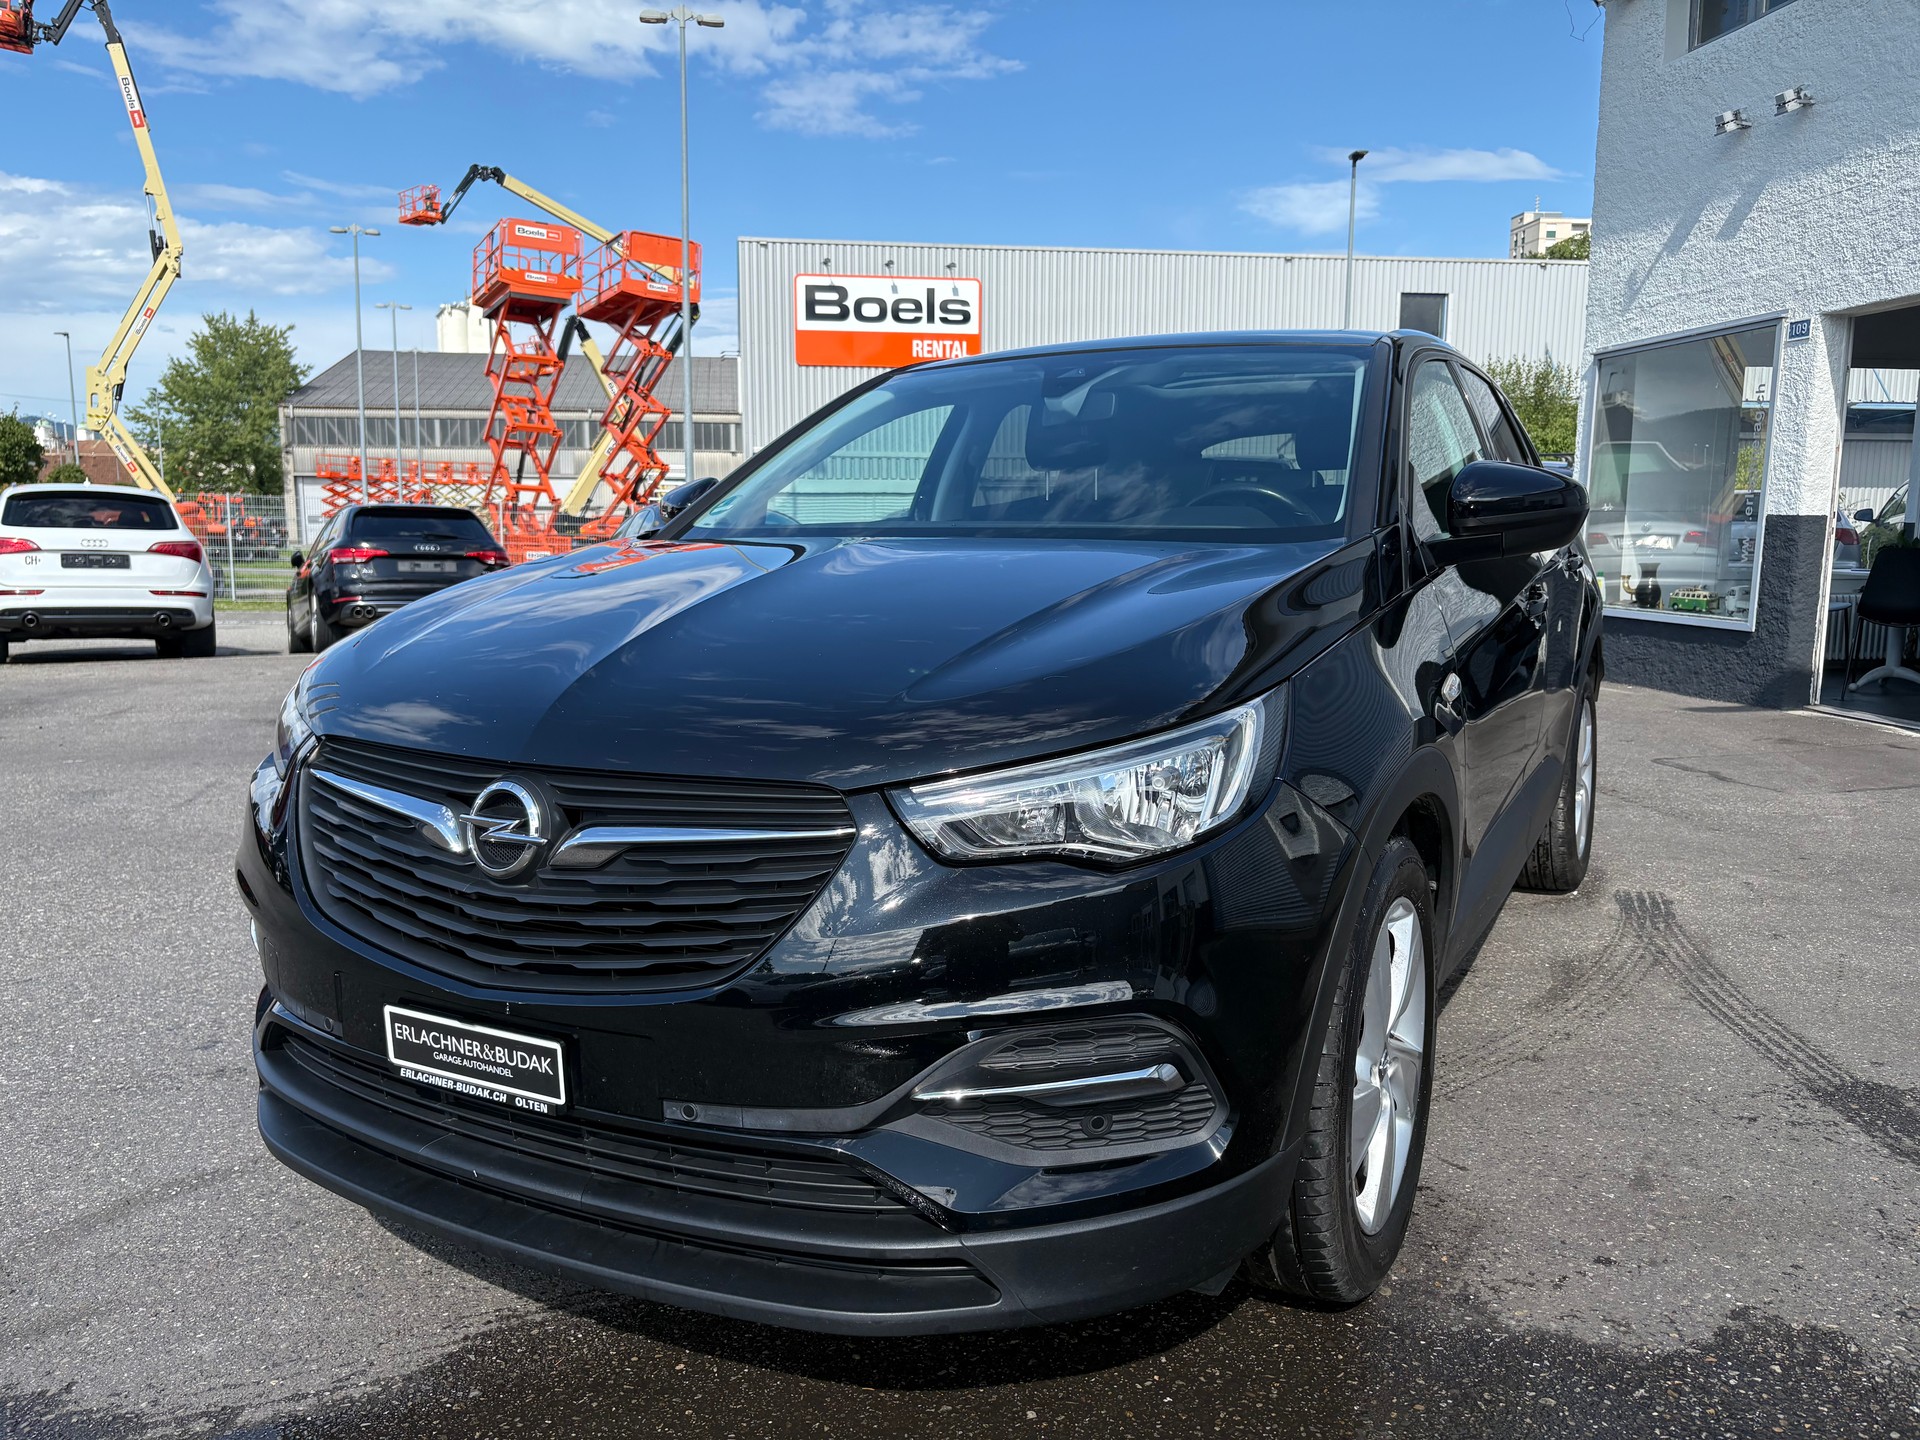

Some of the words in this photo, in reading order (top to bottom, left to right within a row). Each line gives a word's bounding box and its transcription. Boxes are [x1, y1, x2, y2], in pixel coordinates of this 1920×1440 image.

[121, 77, 135, 109] Boels
[517, 227, 546, 237] Boels
[805, 284, 971, 325] Boels
[1791, 322, 1807, 336] 109
[912, 339, 969, 359] RENTAL
[394, 1022, 553, 1075] ERLACHNER&BUDAK
[433, 1051, 462, 1066] GARAGE
[462, 1060, 513, 1078] AUTOHANDEL
[400, 1067, 507, 1103] ERLACHNER-BUDAK.CH
[515, 1096, 548, 1114] OLTEN
